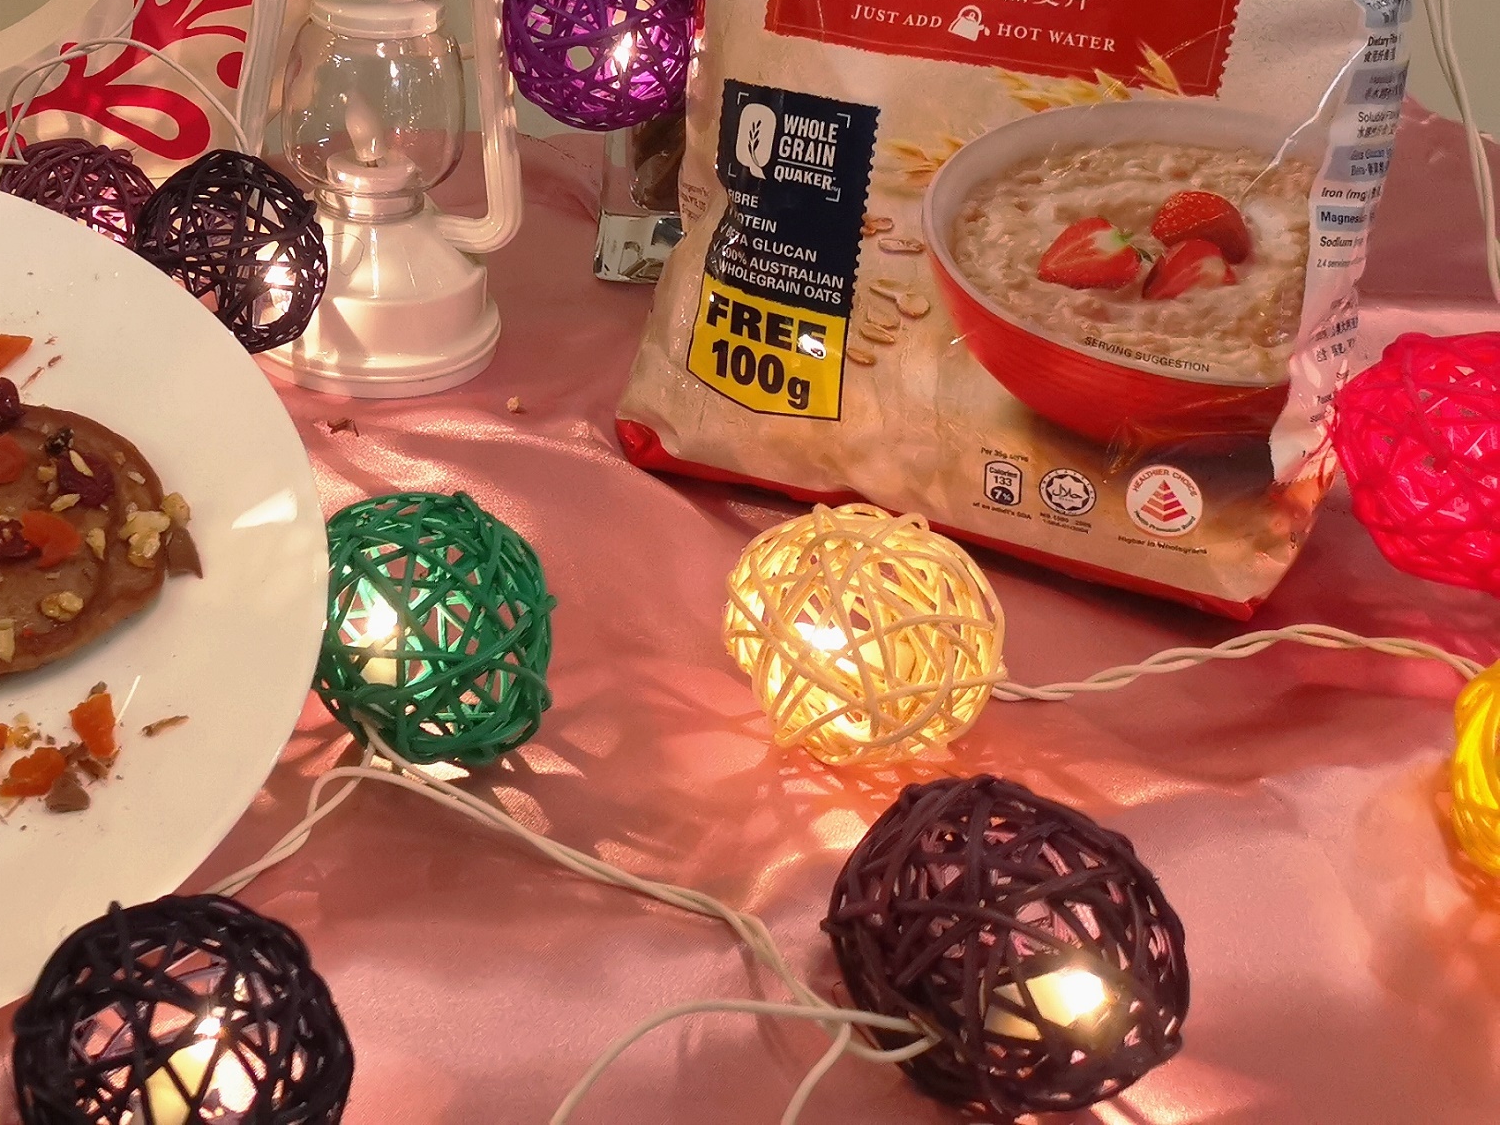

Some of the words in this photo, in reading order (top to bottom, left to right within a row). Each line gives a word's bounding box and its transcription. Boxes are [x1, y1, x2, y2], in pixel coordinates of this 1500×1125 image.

[850, 4, 900, 25] JUST
[903, 12, 943, 29] ADD
[998, 23, 1043, 43] HOT
[1048, 29, 1116, 53] WATER
[784, 113, 839, 144] WHOLE
[778, 135, 836, 167] GRAIN
[773, 164, 833, 191] QUAKER
[752, 237, 817, 262] GLUCAN
[718, 259, 800, 295] WHOLEGRAIN
[804, 286, 842, 305] OATS
[749, 257, 844, 289] AUSTRALIAN
[706, 291, 827, 359] FREE
[1084, 336, 1132, 358] SERVING
[1135, 351, 1210, 373] SUGGESTION
[711, 339, 811, 410] 100g
[993, 476, 1013, 487] 133
[1132, 469, 1170, 492] HEALTHIER
[1172, 472, 1197, 497] CHOICE
[1118, 535, 1145, 545] Higher
